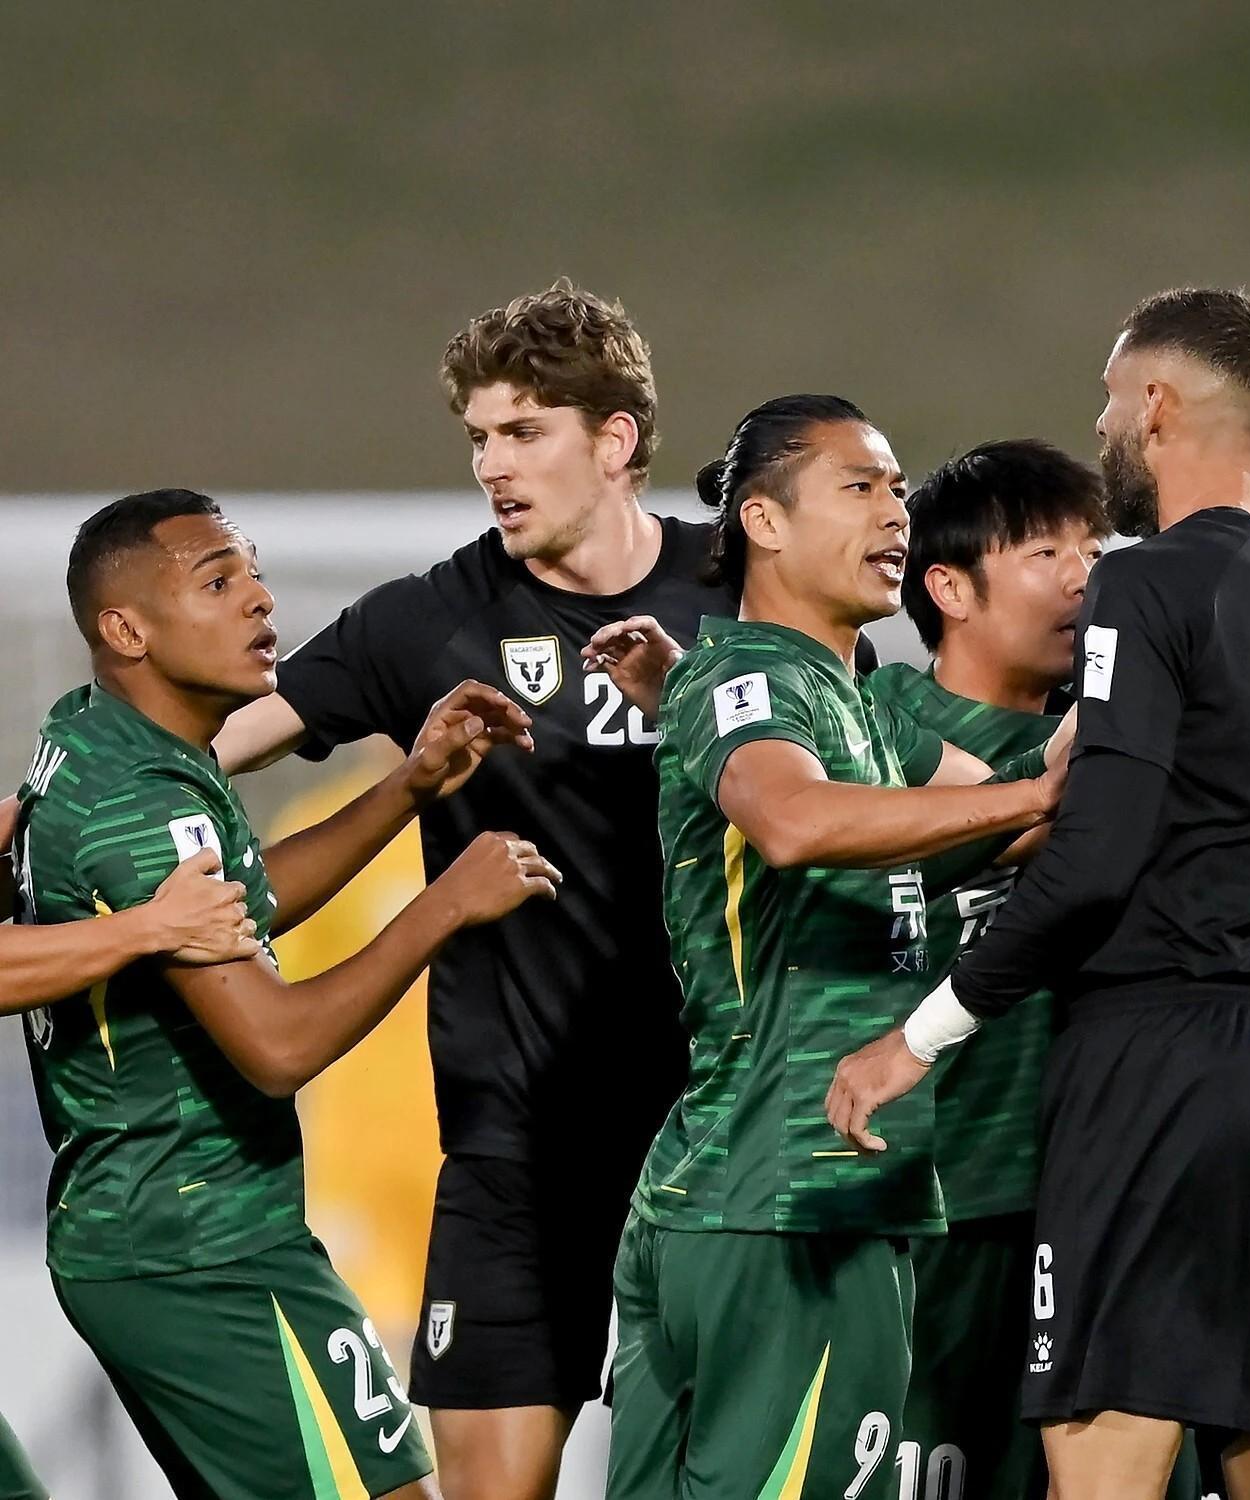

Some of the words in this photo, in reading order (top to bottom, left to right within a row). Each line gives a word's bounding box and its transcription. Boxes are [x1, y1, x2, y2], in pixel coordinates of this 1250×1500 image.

[1034, 1243, 1055, 1320] 6
[844, 1411, 890, 1500] 9
[895, 1441, 966, 1500] 10
